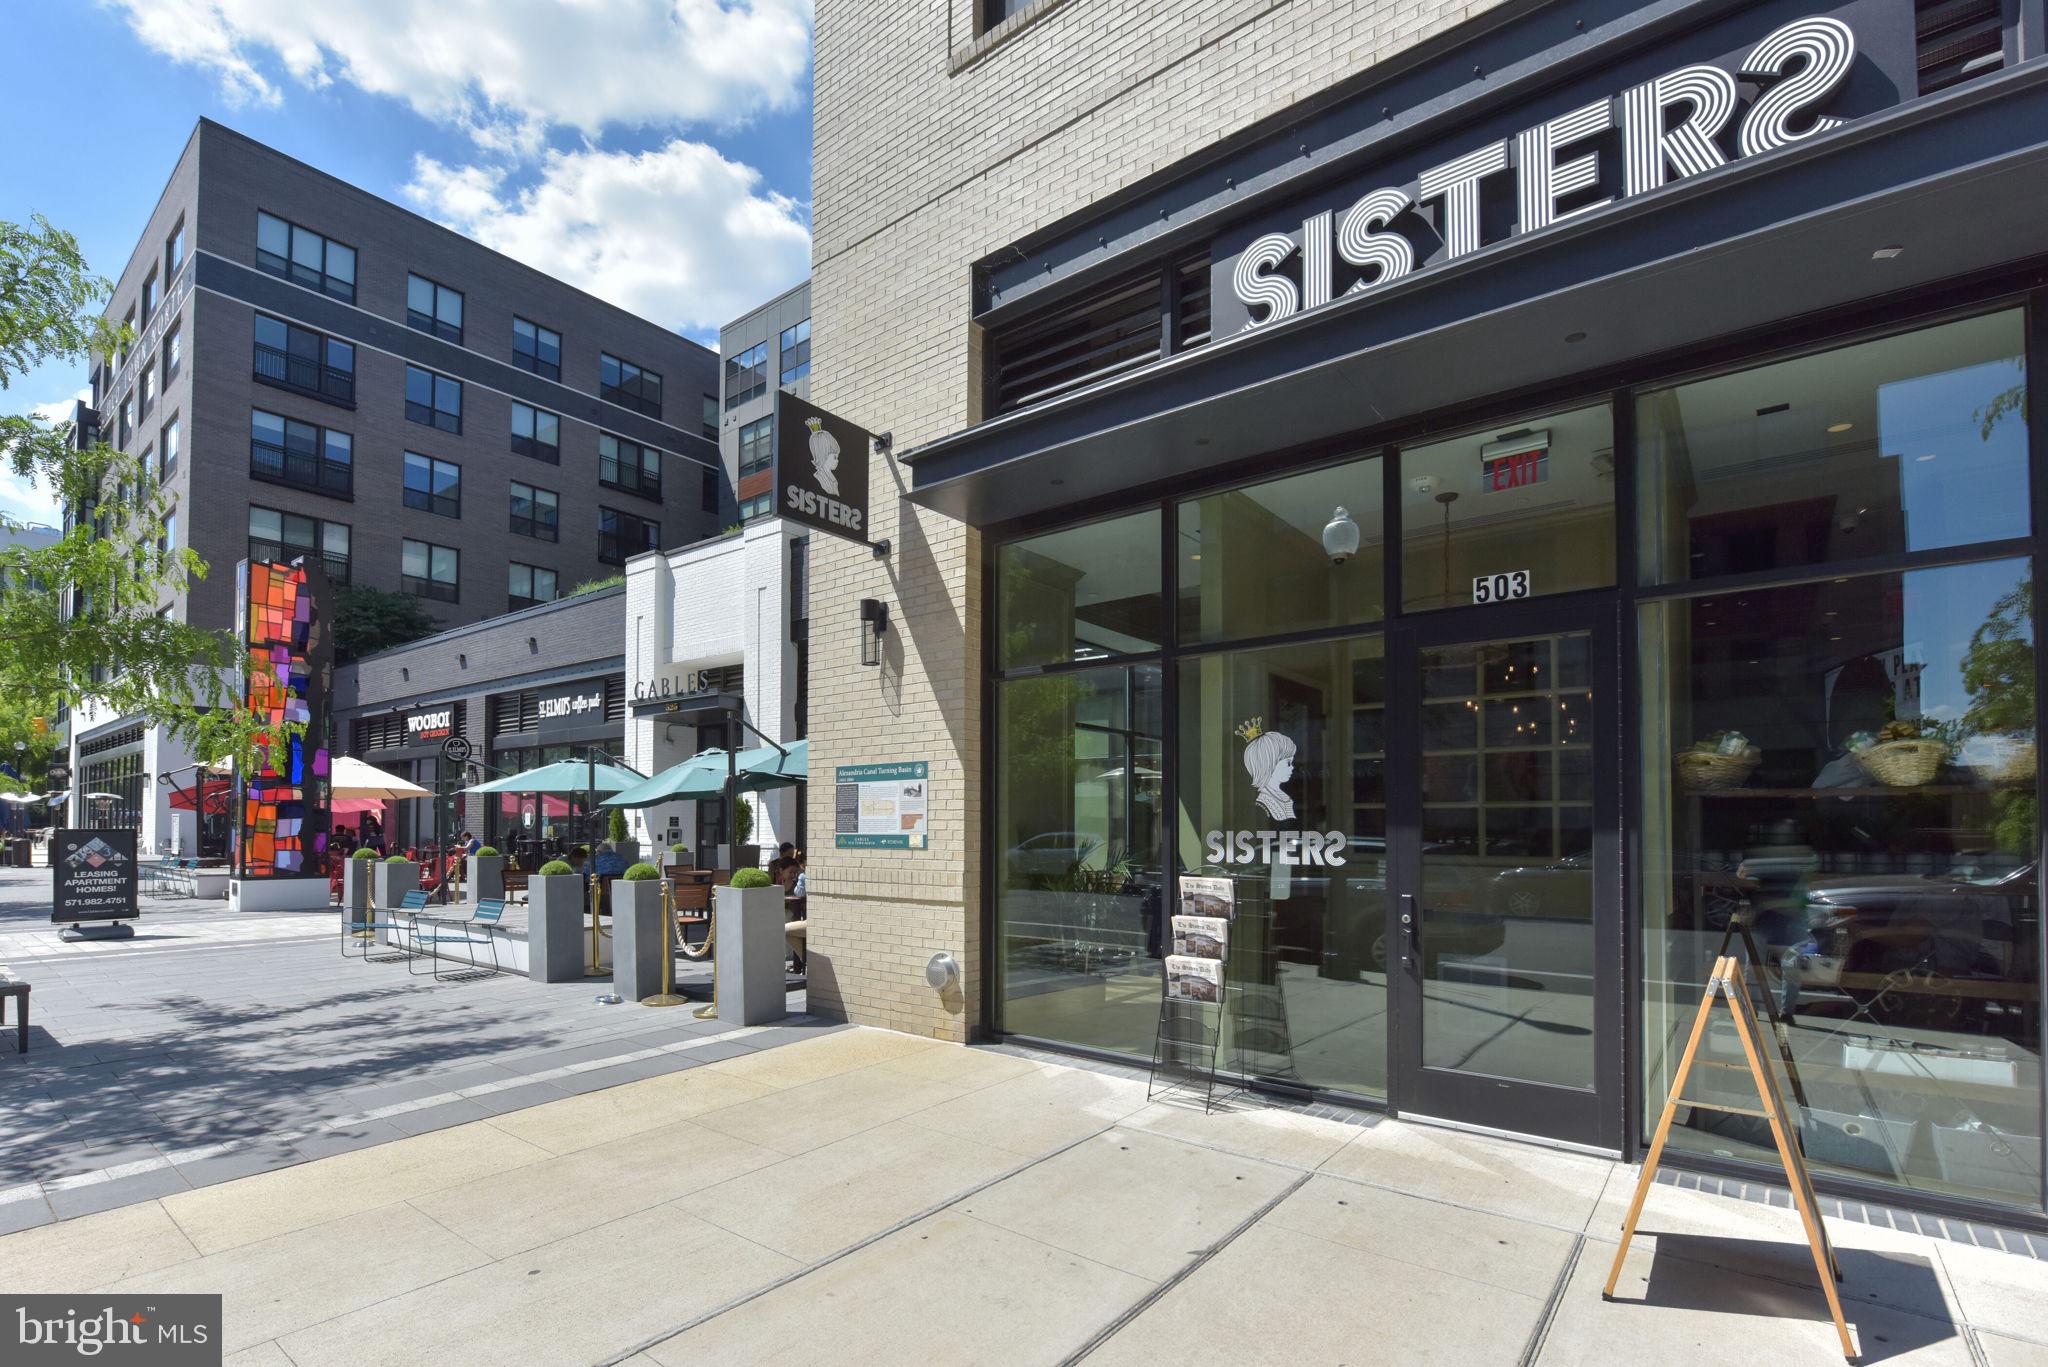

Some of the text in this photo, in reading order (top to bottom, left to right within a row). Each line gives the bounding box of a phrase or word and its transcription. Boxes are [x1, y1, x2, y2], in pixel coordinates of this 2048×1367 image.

[1233, 17, 1856, 333] SISTERS
[1491, 449, 1541, 491] EXIT
[787, 485, 862, 531] SISTERS
[1476, 571, 1528, 603] 503
[634, 670, 708, 701] GABLES
[407, 711, 450, 732] WOOBOI
[1206, 830, 1347, 867] SISTERS
[64, 877, 128, 887] APARTMENT
[74, 870, 118, 878] LEASING
[75, 885, 117, 893] HOMES!
[64, 897, 126, 906] 571.982.4751
